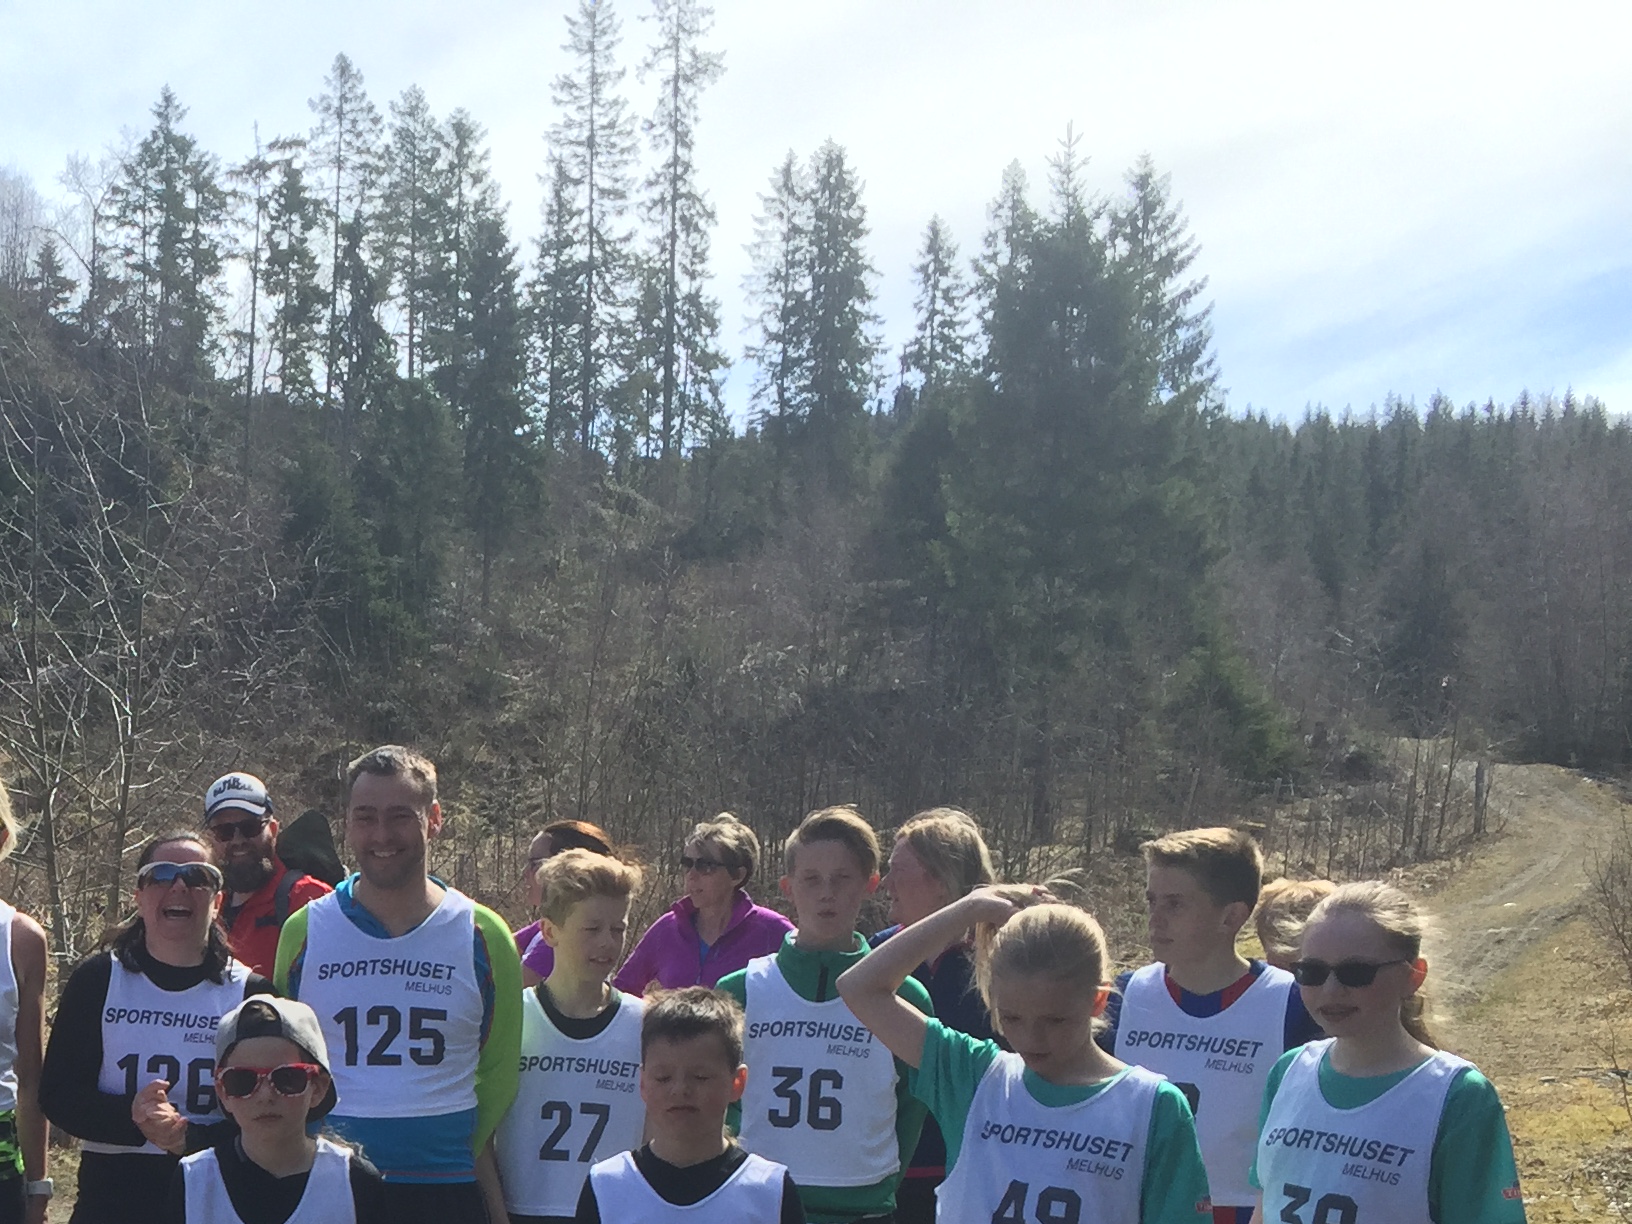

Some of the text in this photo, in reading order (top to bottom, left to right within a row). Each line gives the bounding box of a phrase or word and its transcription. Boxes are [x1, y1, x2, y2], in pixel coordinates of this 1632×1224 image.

[318, 958, 456, 981] SPORTSHUSET
[405, 981, 453, 996] MELHUS
[104, 1007, 221, 1030] SPORTSHUSE
[333, 1005, 447, 1066] 125
[1125, 1030, 1263, 1059] SPORTSHUSET
[826, 1044, 871, 1059] MELHUS
[519, 1056, 640, 1078] SPORTSHUSET
[1204, 1058, 1255, 1074] MELHUS
[595, 1079, 636, 1093] MELHUS
[768, 1066, 844, 1131] 36
[539, 1100, 611, 1163] 27
[981, 1120, 1134, 1162] SPORTSHUSET
[1265, 1127, 1415, 1167] SPORTSHUSET
[1066, 1157, 1125, 1181] MELHUS
[1342, 1163, 1402, 1186] MELHUS
